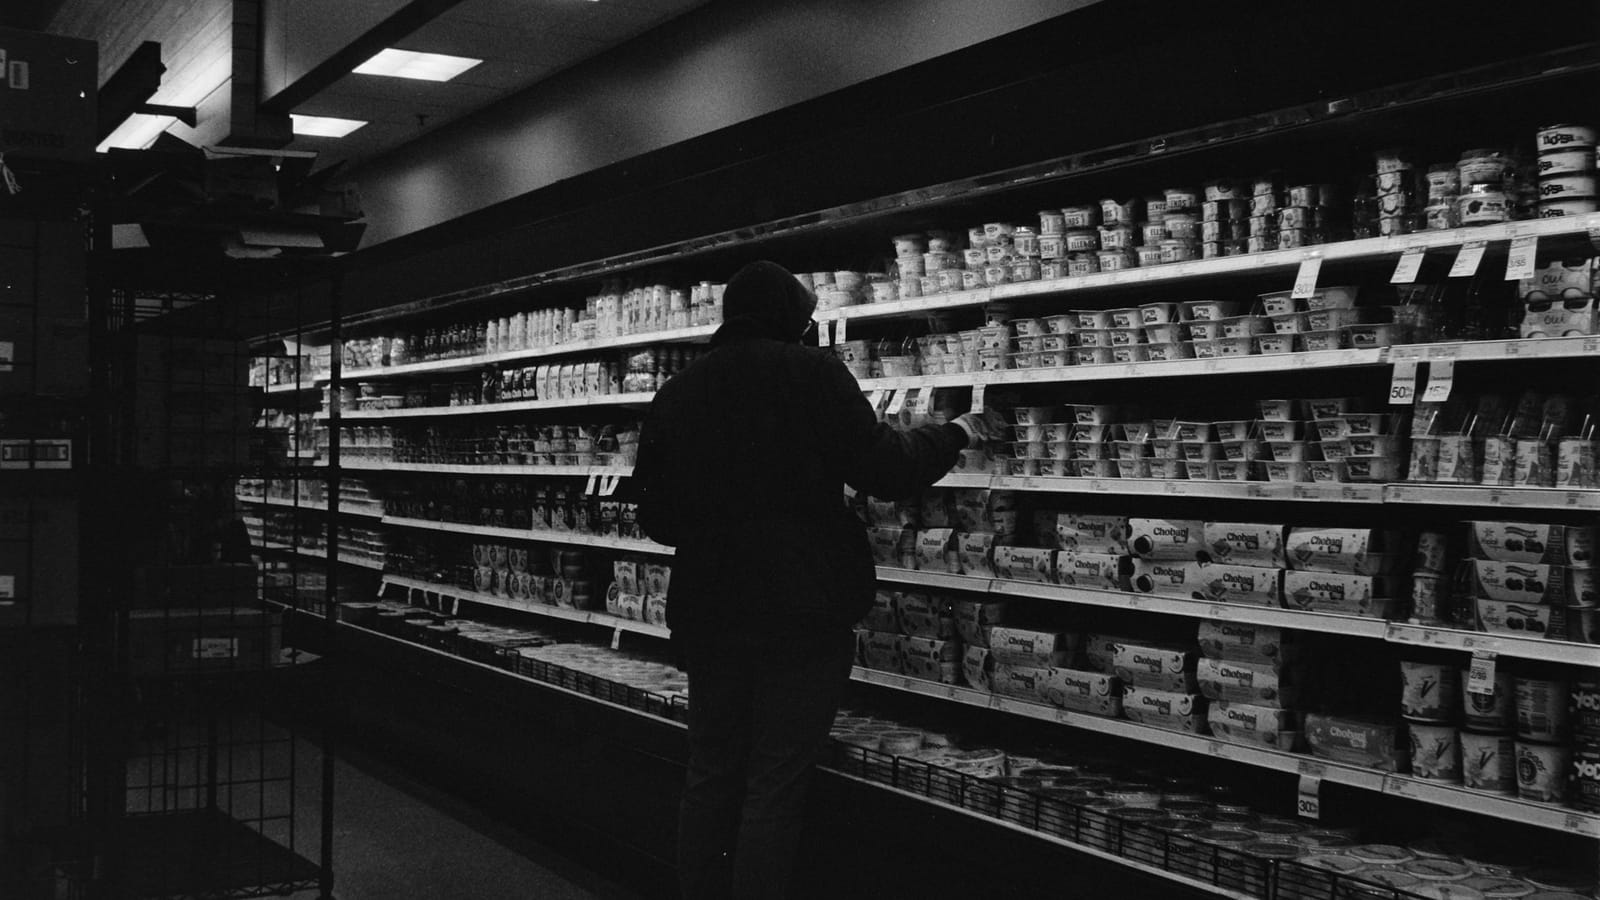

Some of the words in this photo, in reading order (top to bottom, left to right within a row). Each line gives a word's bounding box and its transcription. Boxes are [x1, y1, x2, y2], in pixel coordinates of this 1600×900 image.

[1153, 527, 1189, 538] Chobani
[1227, 532, 1259, 543] Chobani
[1310, 535, 1344, 546] Chobani
[1153, 566, 1185, 578] Chobani
[1222, 573, 1254, 583] Chobani
[1309, 581, 1345, 592] Chobani
[1133, 655, 1162, 667] Chobani
[1221, 668, 1254, 681] Chobani
[1142, 696, 1170, 709] Chobani
[1228, 711, 1257, 723] Chobani
[1330, 726, 1366, 741] Chobani
